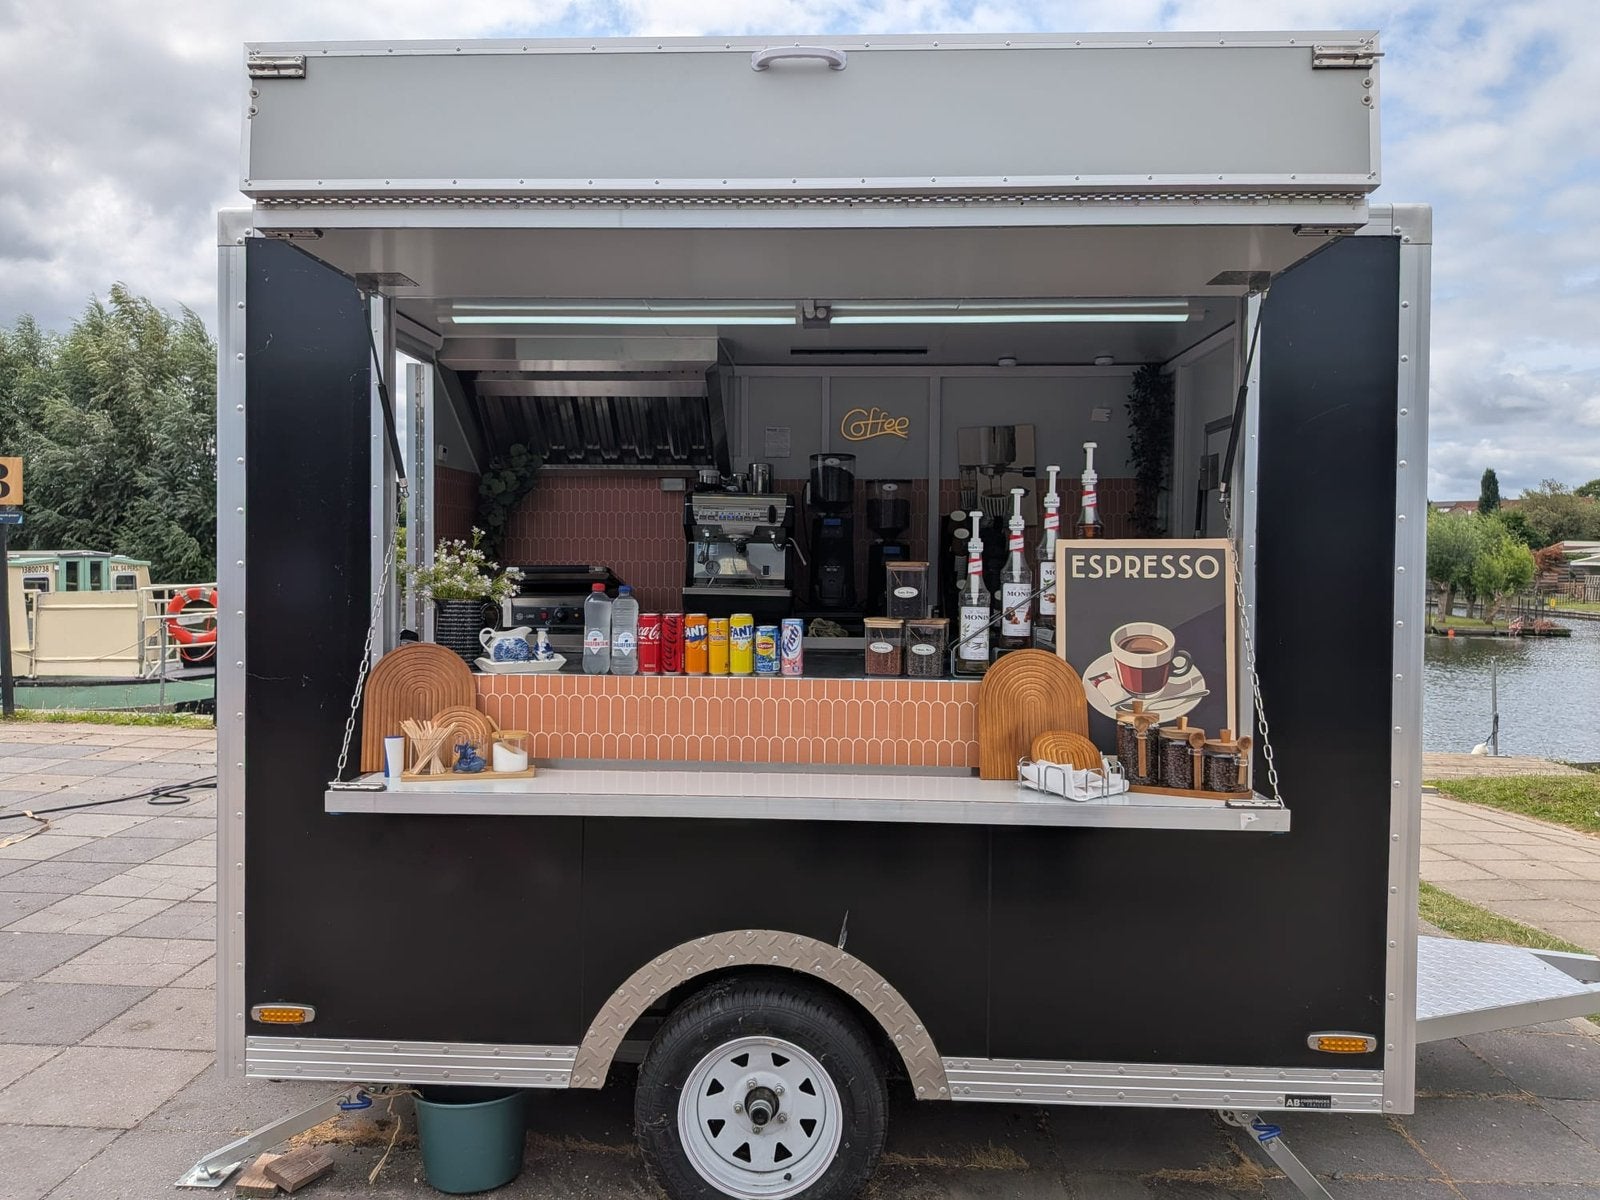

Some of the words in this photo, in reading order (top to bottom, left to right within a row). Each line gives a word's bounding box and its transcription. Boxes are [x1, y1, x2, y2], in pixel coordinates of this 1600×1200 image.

[841, 407, 909, 441] Coffee
[1071, 554, 1220, 579] ESPRESSO
[782, 624, 799, 657] Fristi
[1286, 1099, 1301, 1107] AB
